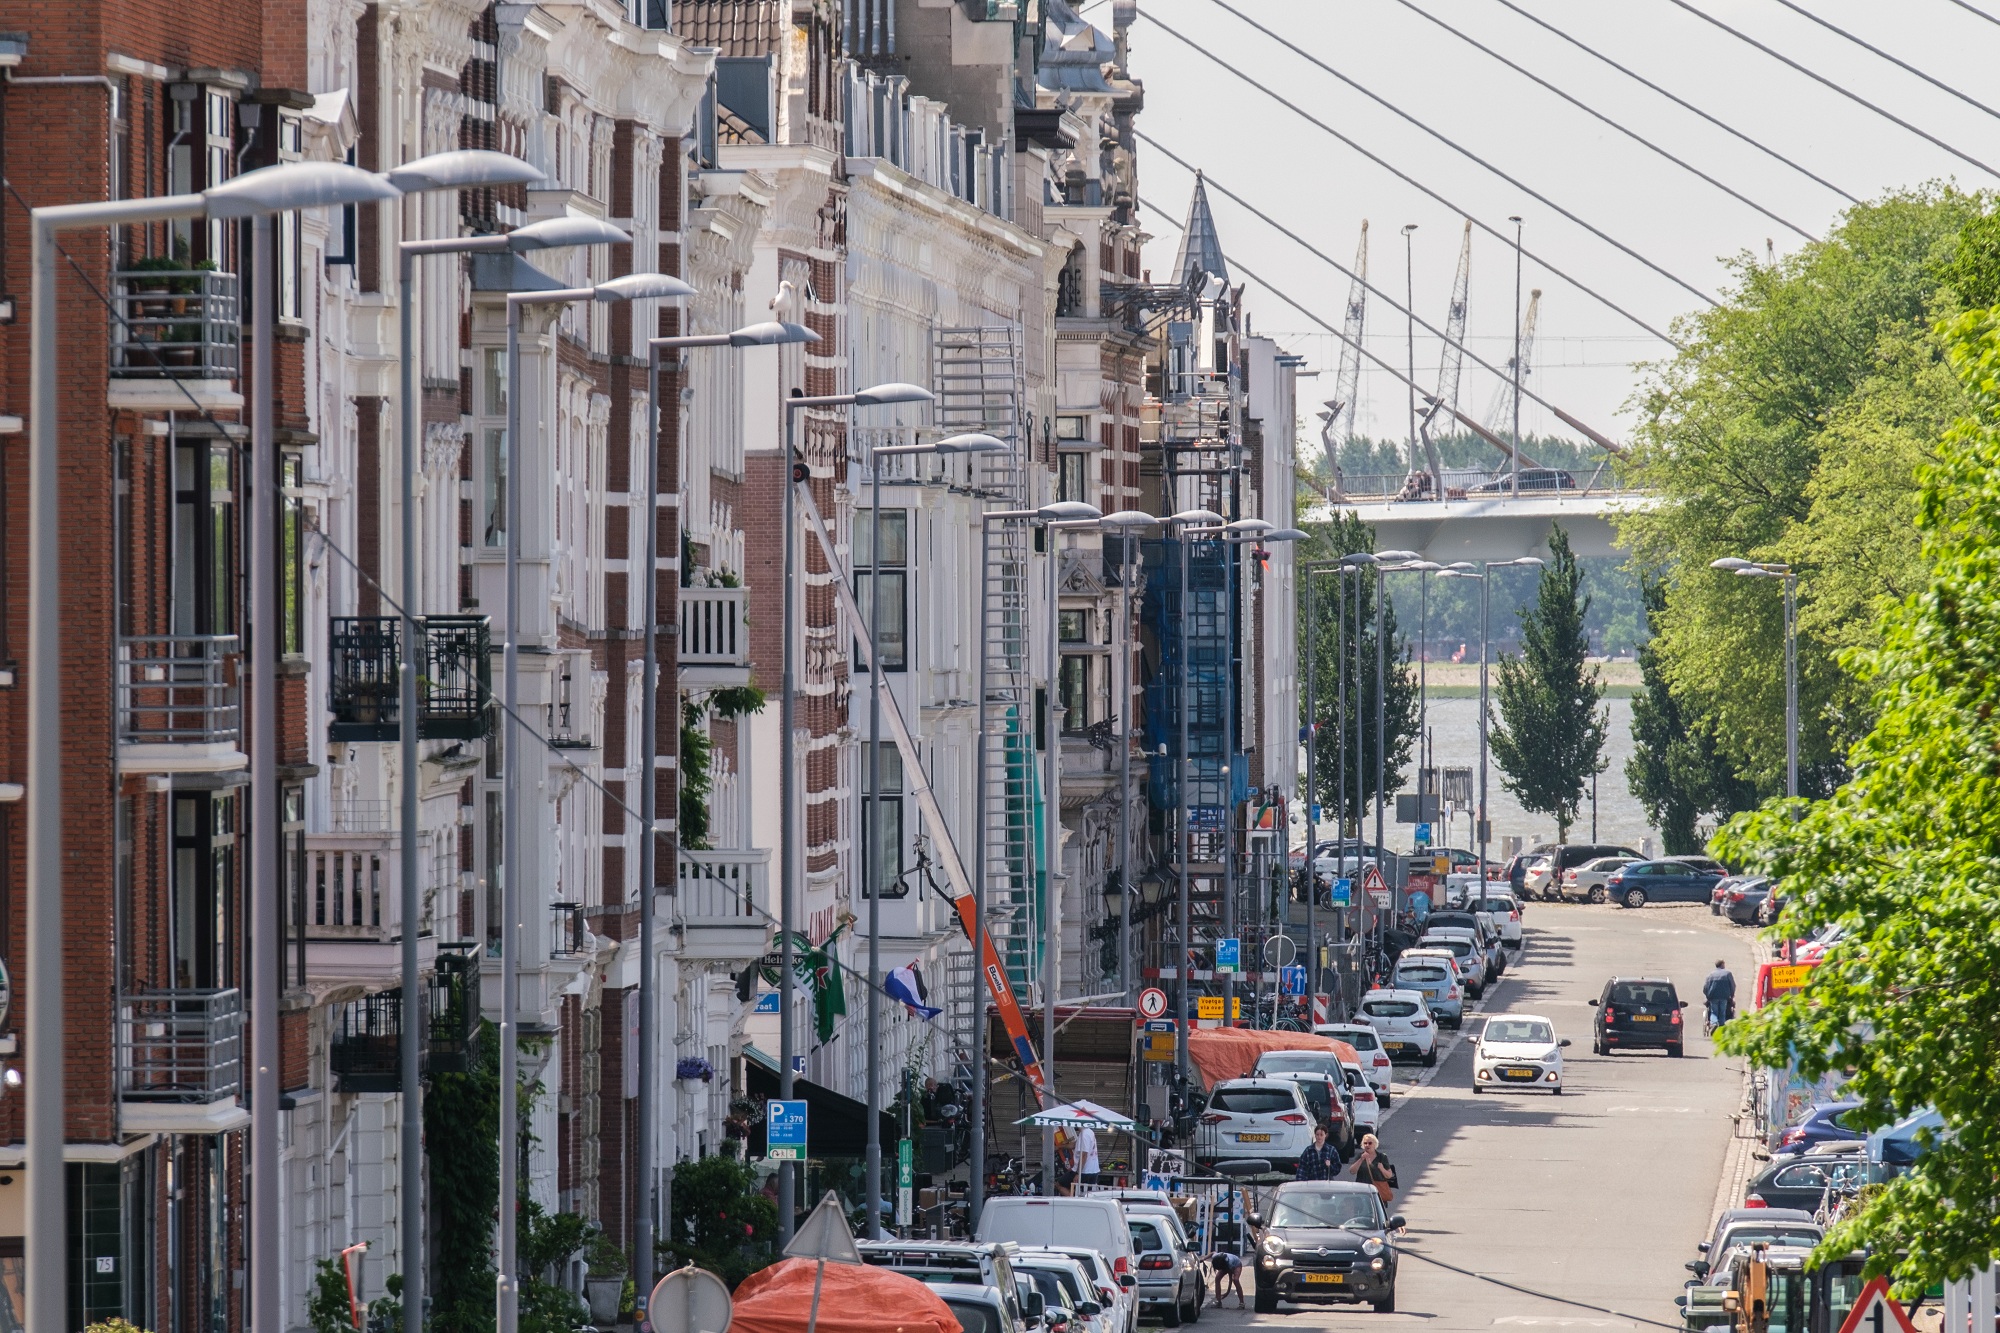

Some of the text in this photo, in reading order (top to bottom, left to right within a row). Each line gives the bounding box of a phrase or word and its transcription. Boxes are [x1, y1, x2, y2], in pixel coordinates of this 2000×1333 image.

[1217, 940, 1226, 952] P
[764, 955, 804, 965] Heike
[988, 966, 1003, 992] Boels
[799, 1057, 806, 1071] P
[770, 1103, 804, 1123] P 370
[1034, 1117, 1136, 1131] Heinekn
[98, 1258, 111, 1271] 75
